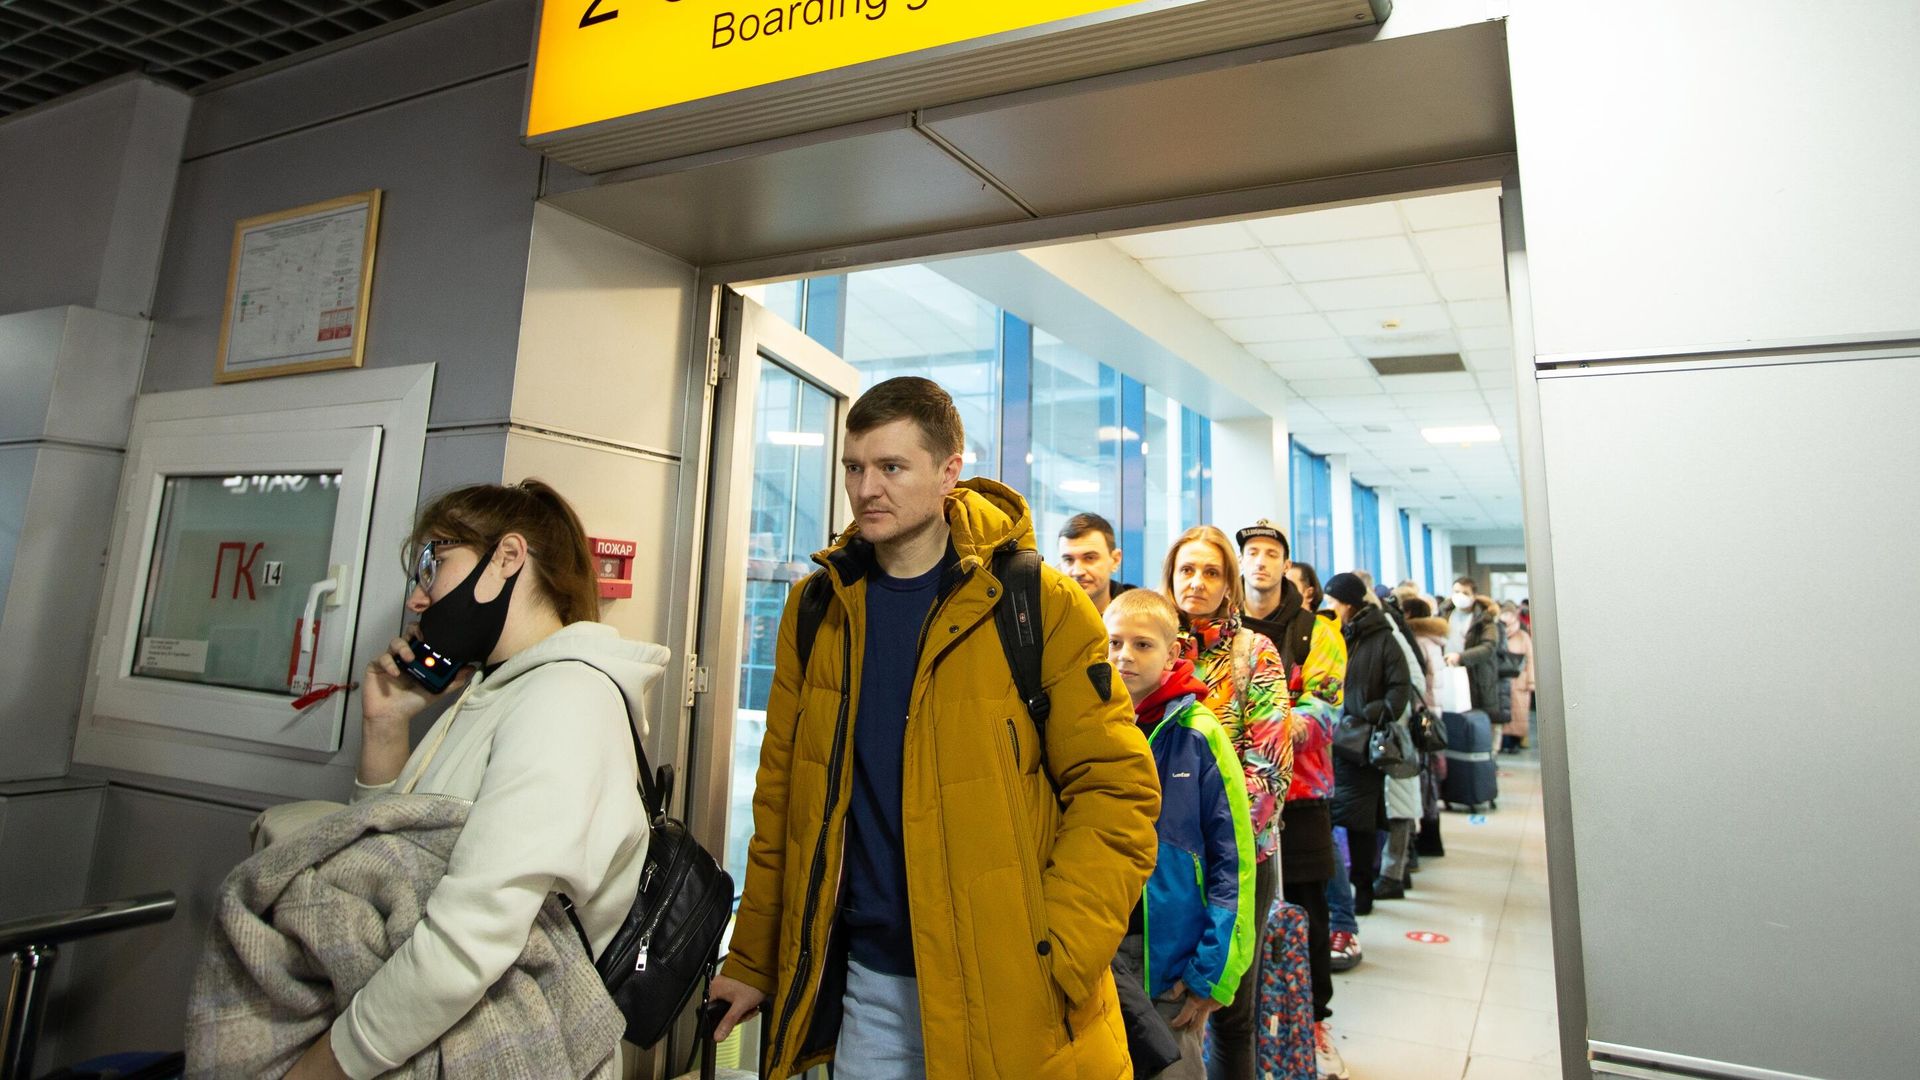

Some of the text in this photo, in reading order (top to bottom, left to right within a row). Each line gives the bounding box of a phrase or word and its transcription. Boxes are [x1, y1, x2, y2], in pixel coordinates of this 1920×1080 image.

[712, 0, 886, 49] Boarding
[597, 541, 632, 555] ПОЖАР
[211, 542, 264, 600] ПК
[263, 563, 282, 585] 14
